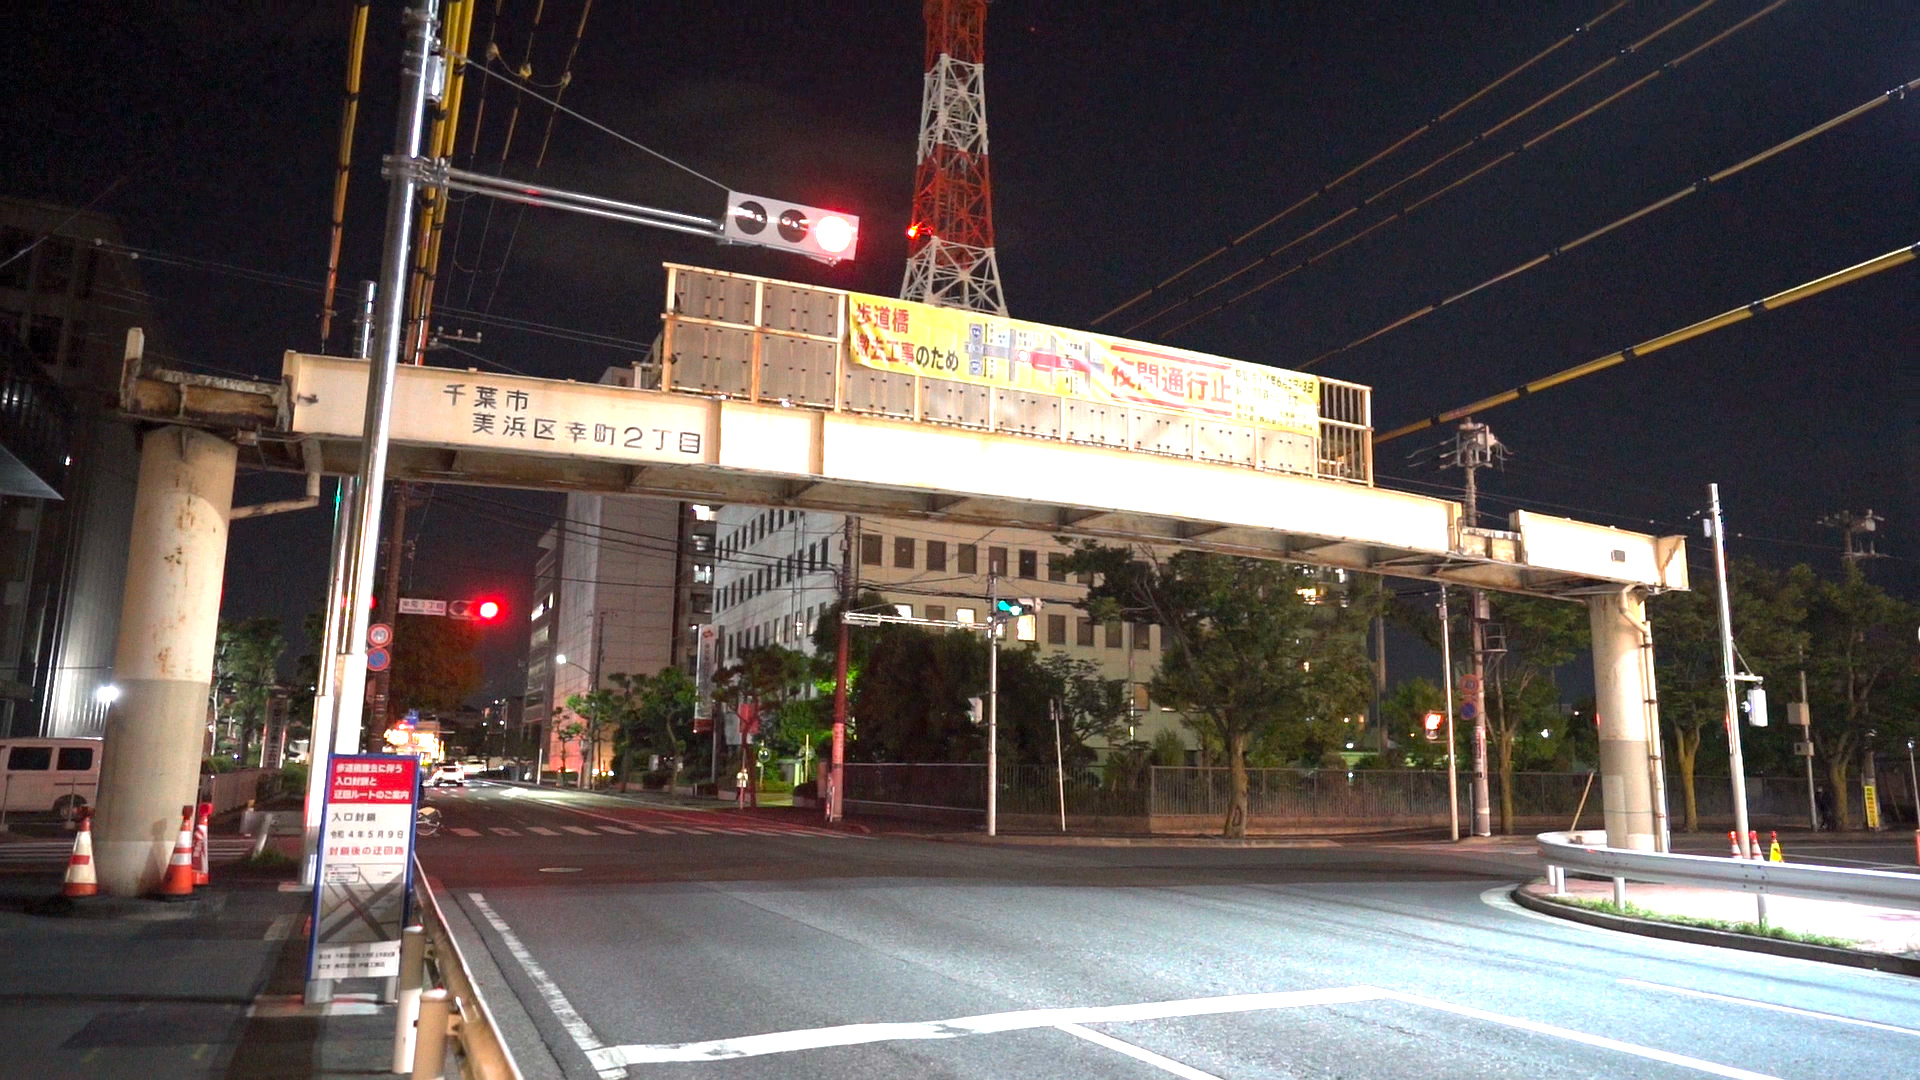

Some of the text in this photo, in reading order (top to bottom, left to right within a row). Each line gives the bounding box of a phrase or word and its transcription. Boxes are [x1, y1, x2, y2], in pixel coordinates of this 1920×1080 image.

[857, 302, 910, 334] 歩道橋
[856, 332, 960, 372] 撤去工事のため
[443, 383, 530, 412] 千葉市
[472, 411, 701, 455] 美浜区幸町2丁目
[334, 776, 378, 786] 入口封鎖と
[333, 789, 410, 800] 迂回ルートのご案内
[331, 812, 377, 822] 入口封鎖
[328, 846, 404, 856] 封鎖後の迂回路
